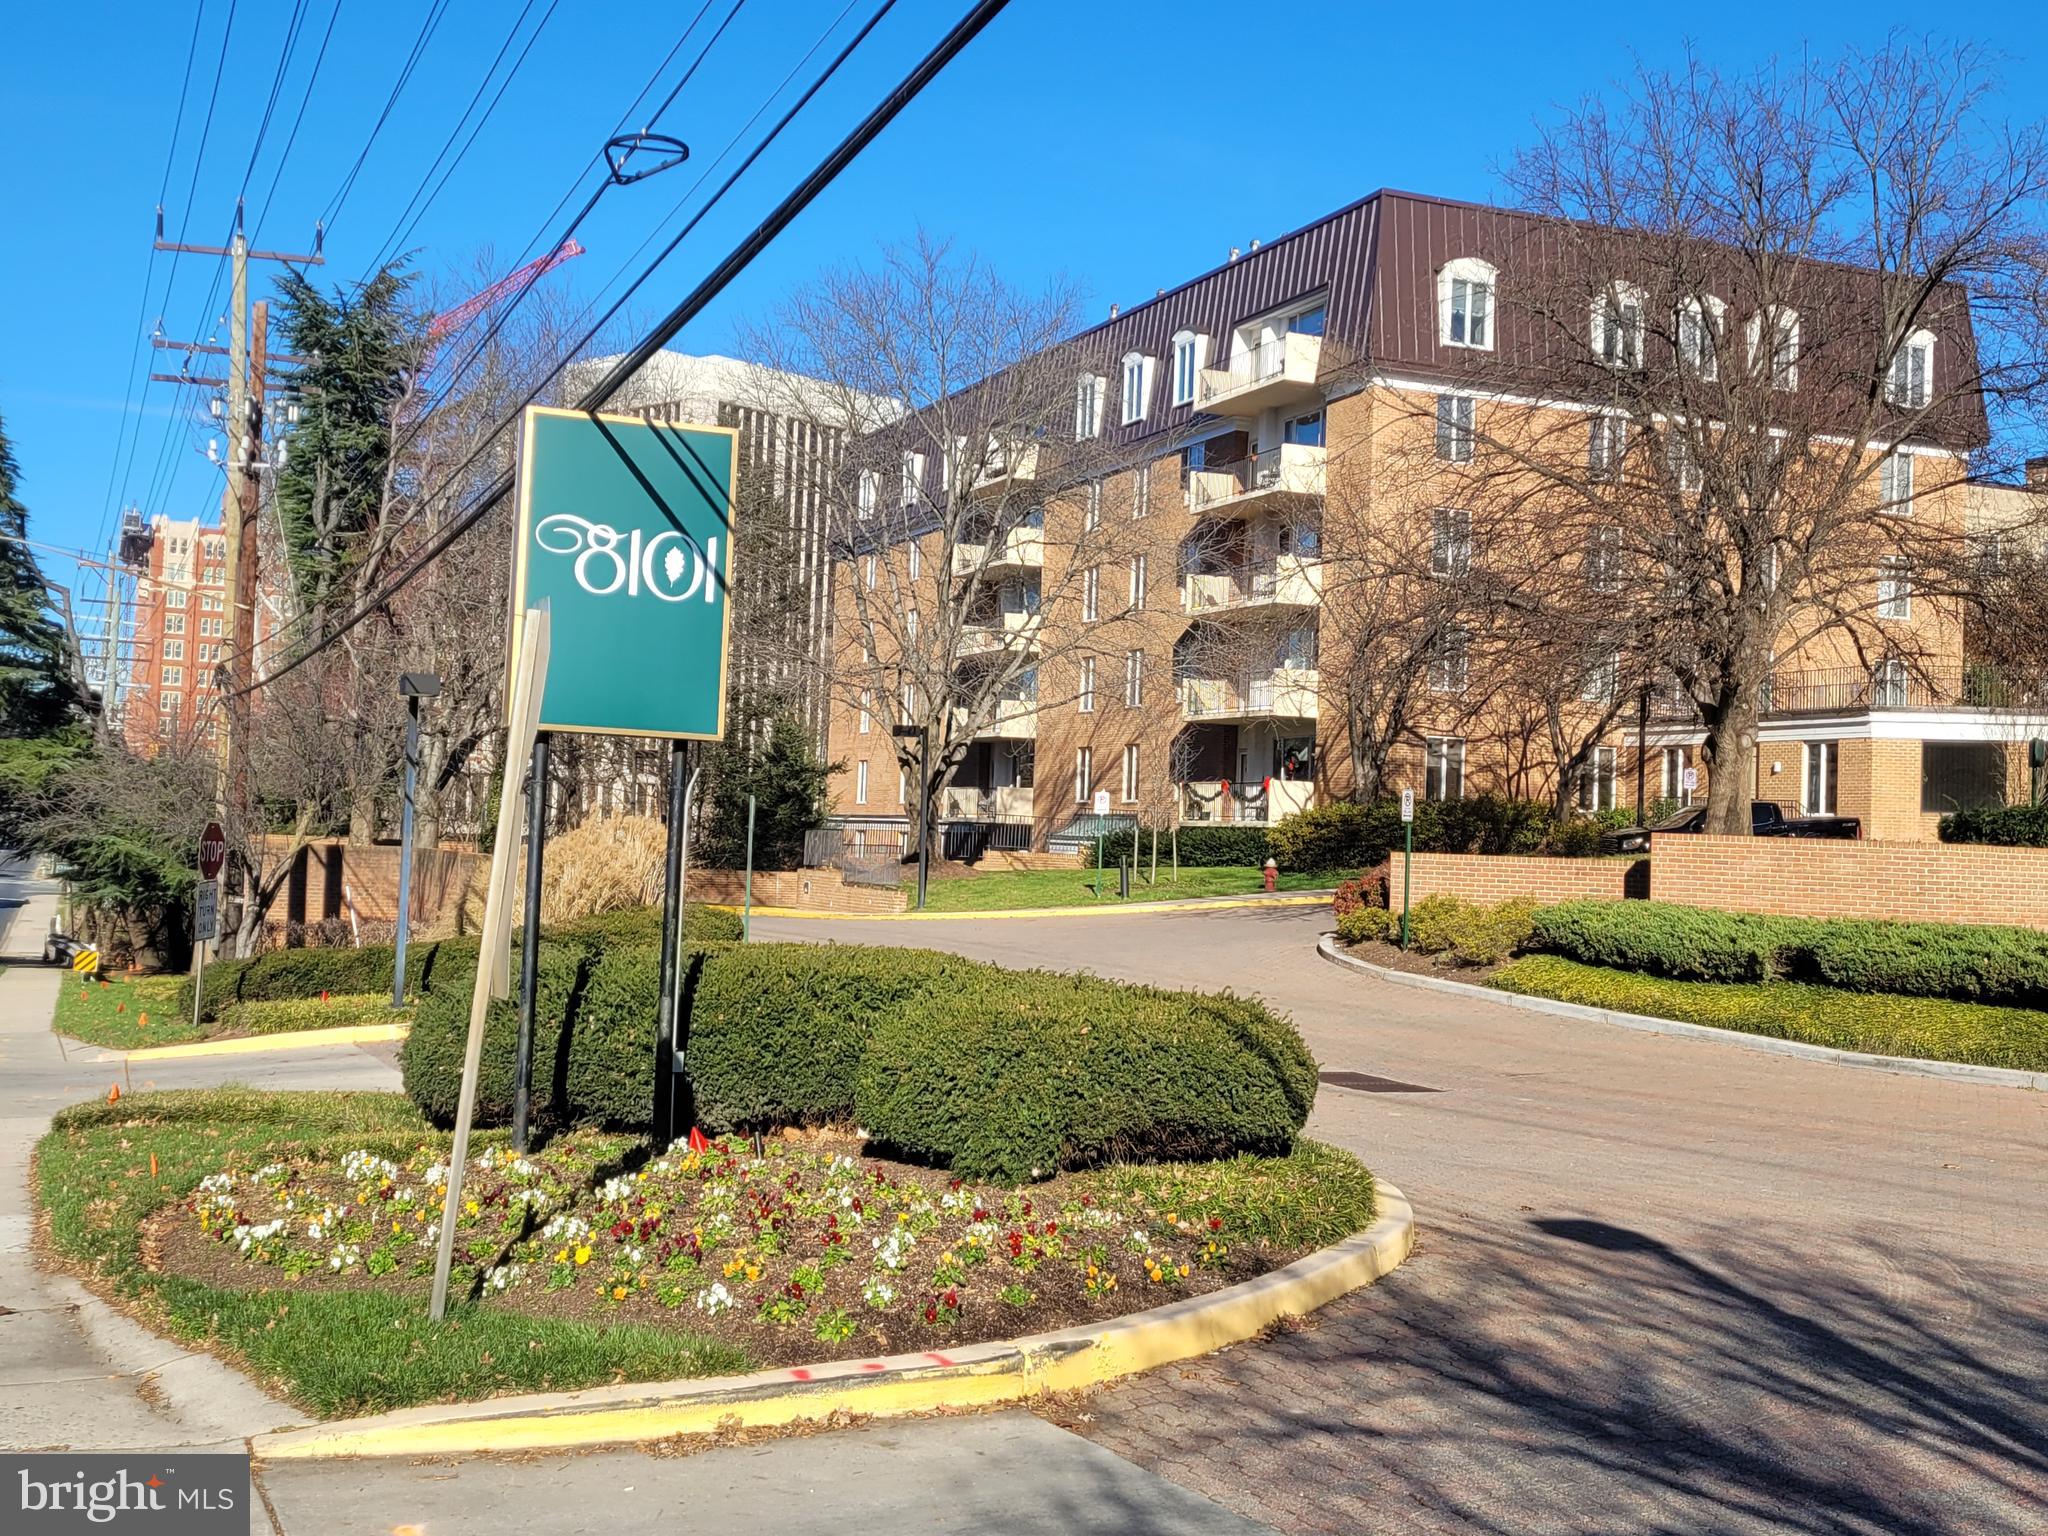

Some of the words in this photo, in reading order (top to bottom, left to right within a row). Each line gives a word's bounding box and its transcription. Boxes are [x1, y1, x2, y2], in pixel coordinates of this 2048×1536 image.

[535, 513, 718, 604] 8101
[200, 840, 224, 861] STOP
[199, 888, 217, 901] RIGHT
[199, 903, 215, 917] TURN
[197, 919, 214, 934] ONLY
